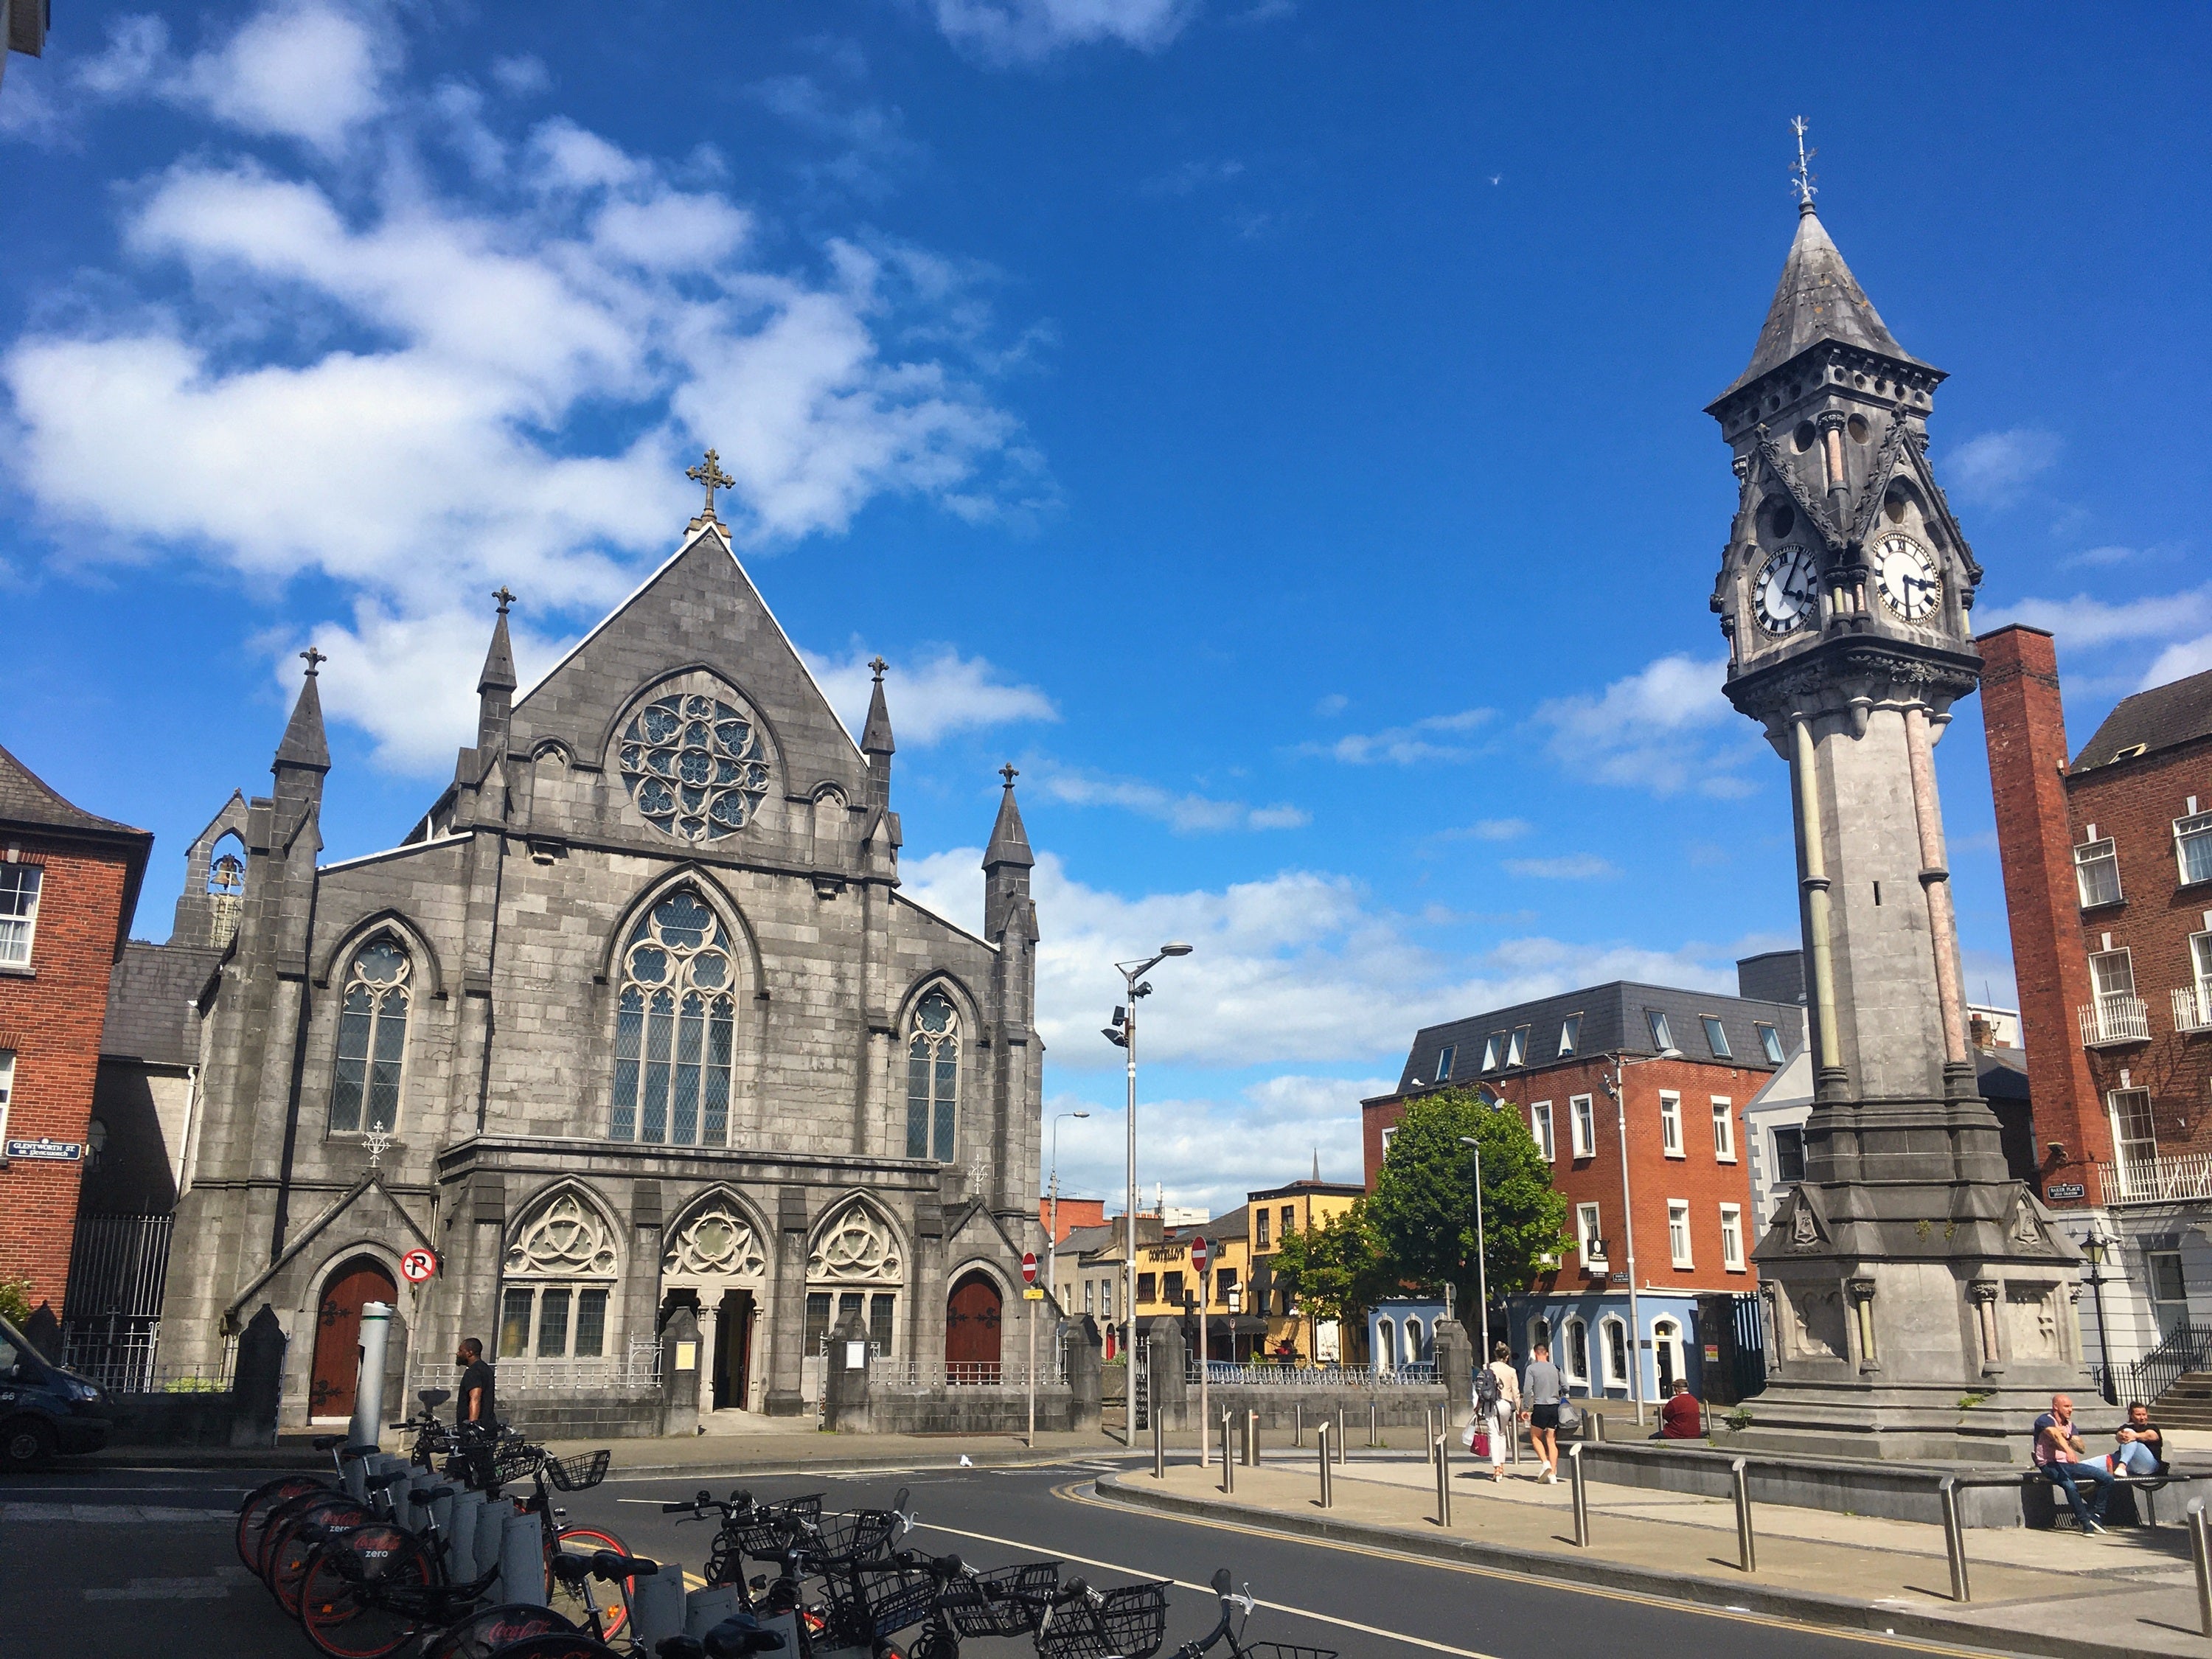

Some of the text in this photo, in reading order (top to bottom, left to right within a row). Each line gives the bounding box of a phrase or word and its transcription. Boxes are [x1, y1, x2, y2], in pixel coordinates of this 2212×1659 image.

[13, 1143, 63, 1151] GLENTWORTH
[1149, 1248, 1185, 1263] COSTELLO'S
[365, 1549, 389, 1558] zero
